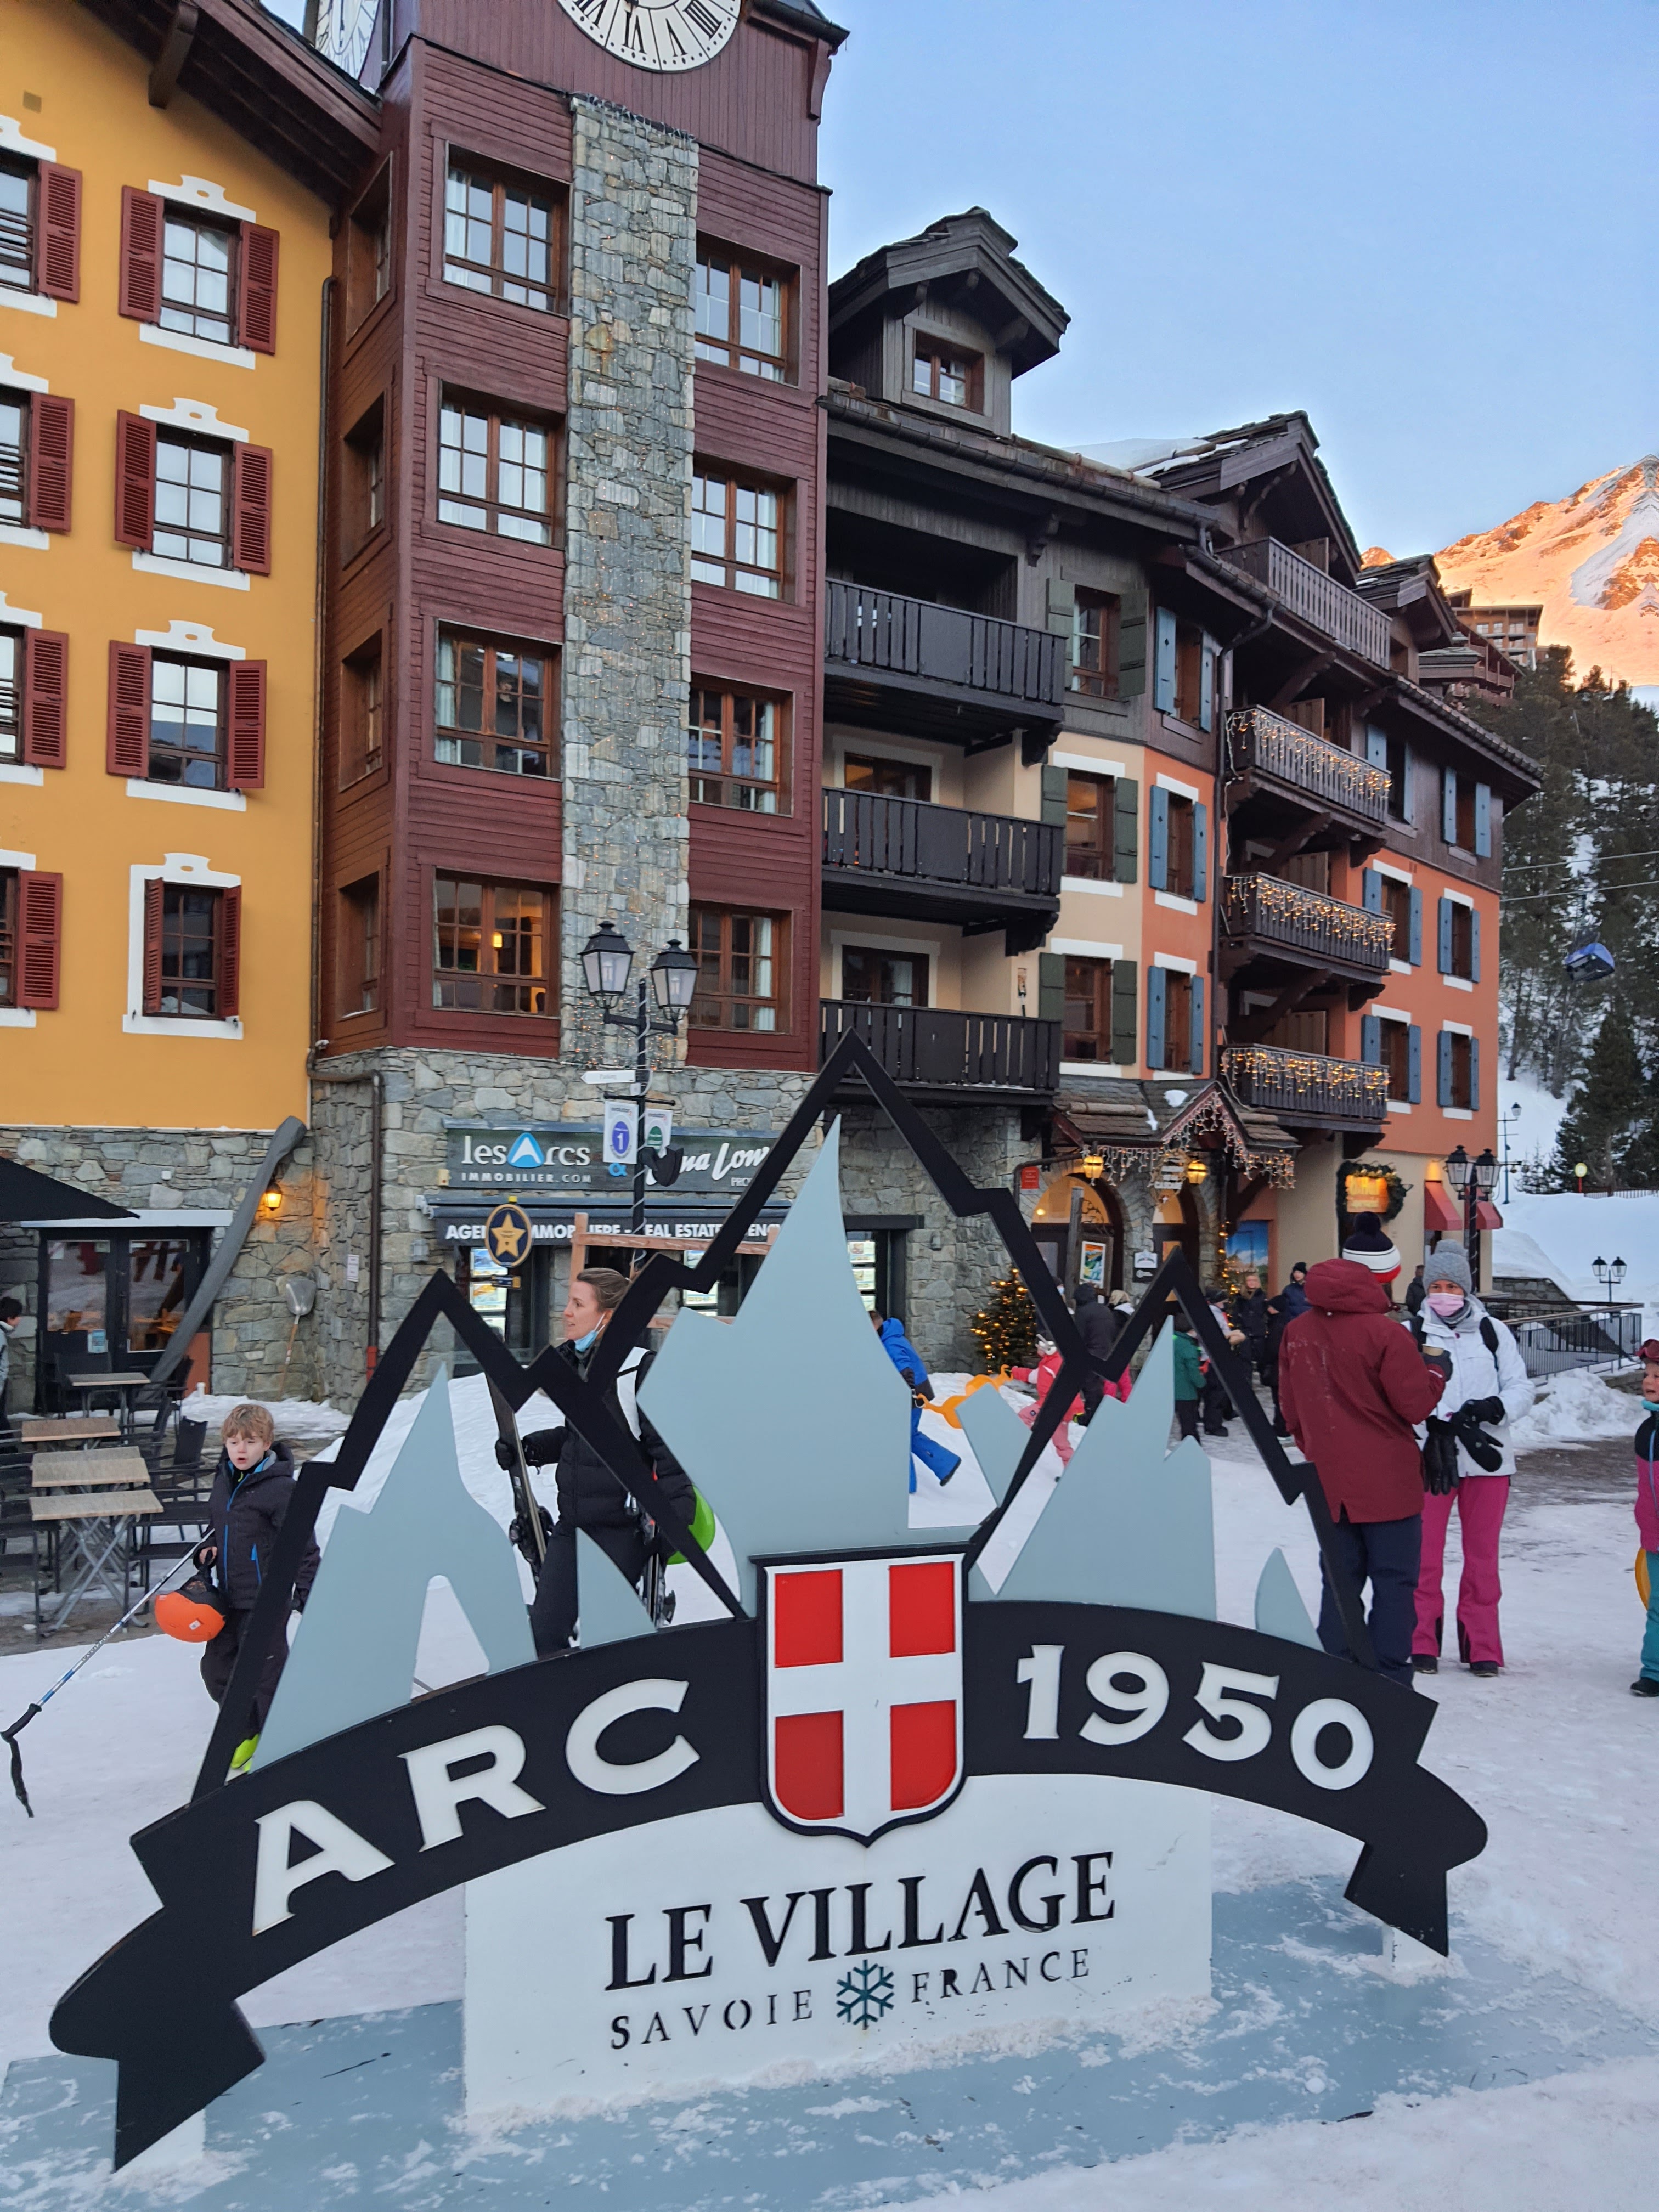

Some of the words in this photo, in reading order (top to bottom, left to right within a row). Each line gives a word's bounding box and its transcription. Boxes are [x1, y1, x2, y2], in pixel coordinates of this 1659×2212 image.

[617, 1132, 624, 1150] 1
[461, 1172, 592, 1183] IMMOBILIER.COM
[445, 1225, 486, 1239] AGE
[644, 1224, 672, 1237] EAL
[252, 1678, 701, 1937] ARC
[1017, 1644, 1374, 1791] 1950
[604, 1904, 713, 1991] LE
[740, 1850, 1115, 1968] VILLAGE
[610, 1989, 814, 2050] SAVOIE
[911, 1948, 1090, 2004] FRANCE
